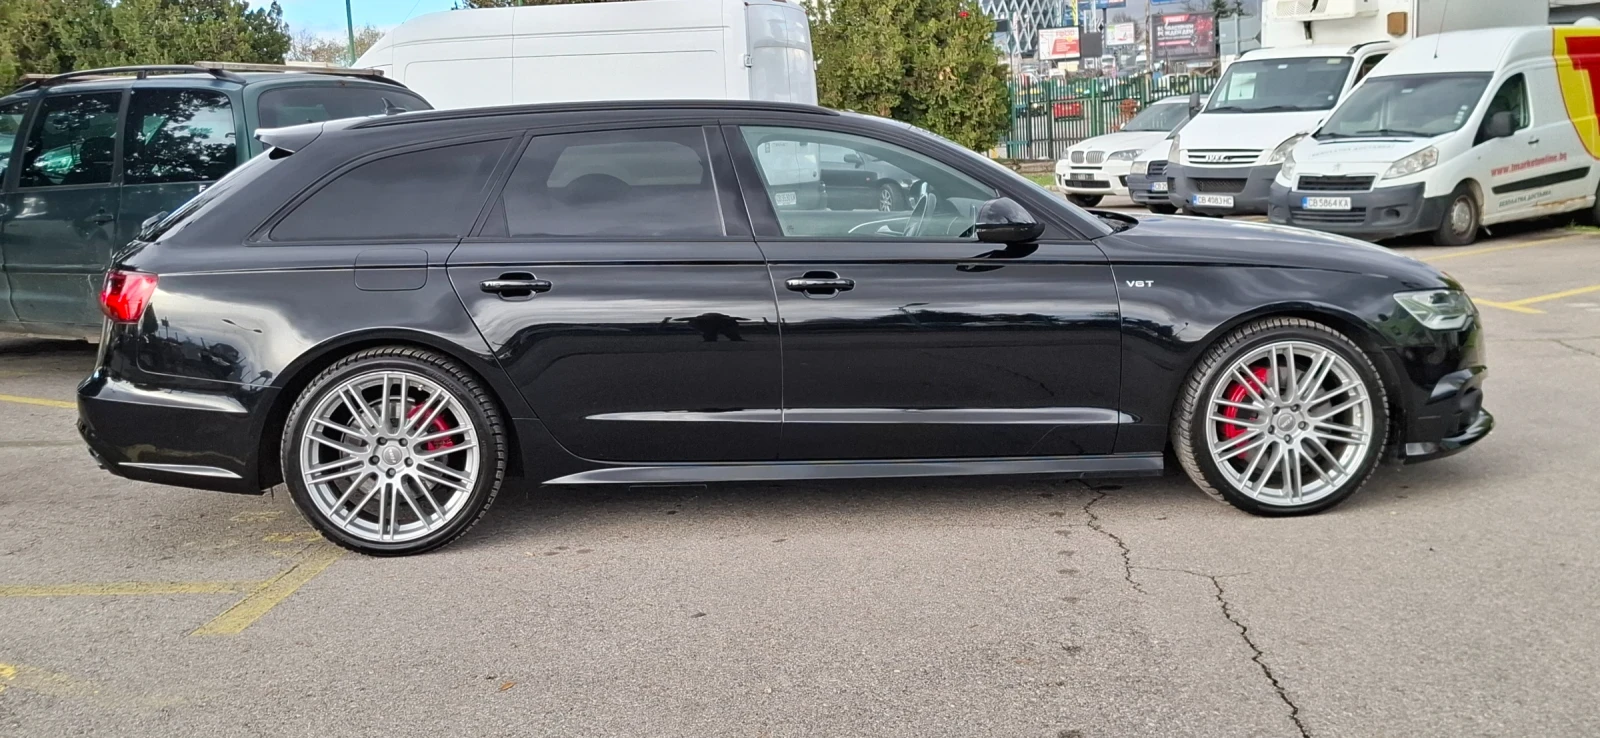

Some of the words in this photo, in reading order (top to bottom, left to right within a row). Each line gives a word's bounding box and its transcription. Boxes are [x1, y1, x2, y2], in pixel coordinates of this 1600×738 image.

[1308, 198, 1318, 207] CB
[1319, 198, 1338, 208] 5864
[1338, 198, 1349, 208] KA
